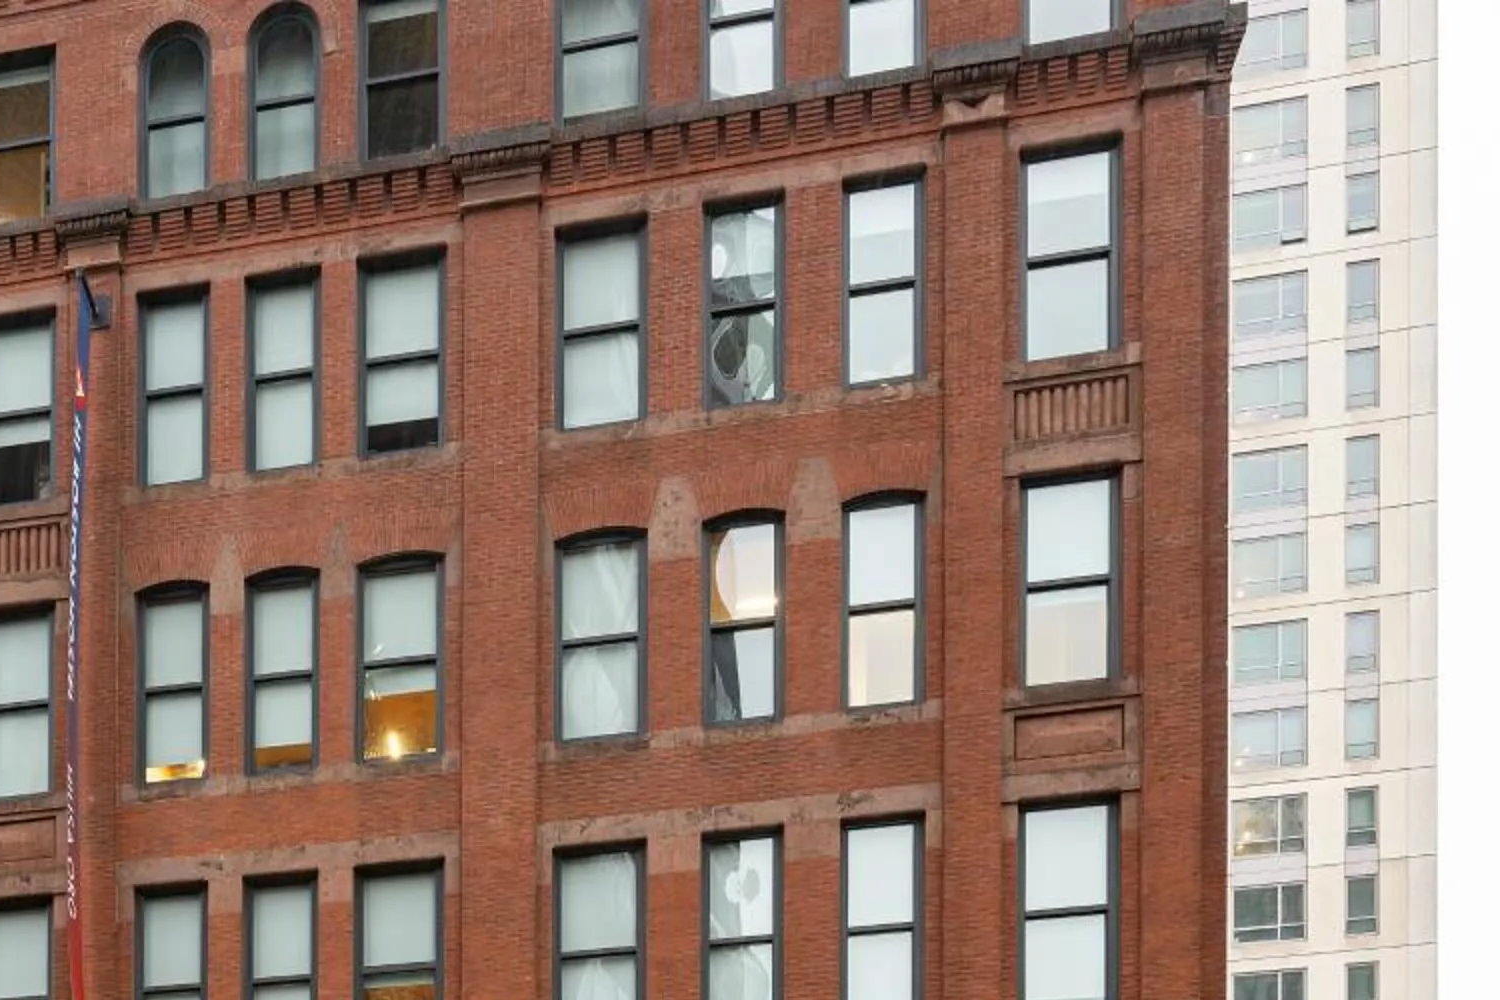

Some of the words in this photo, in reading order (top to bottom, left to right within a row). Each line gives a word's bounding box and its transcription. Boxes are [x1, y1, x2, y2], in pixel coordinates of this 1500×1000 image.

[74, 413, 82, 453] HI
[69, 457, 80, 587] BOSTON
[67, 595, 75, 701] HOSTEL
